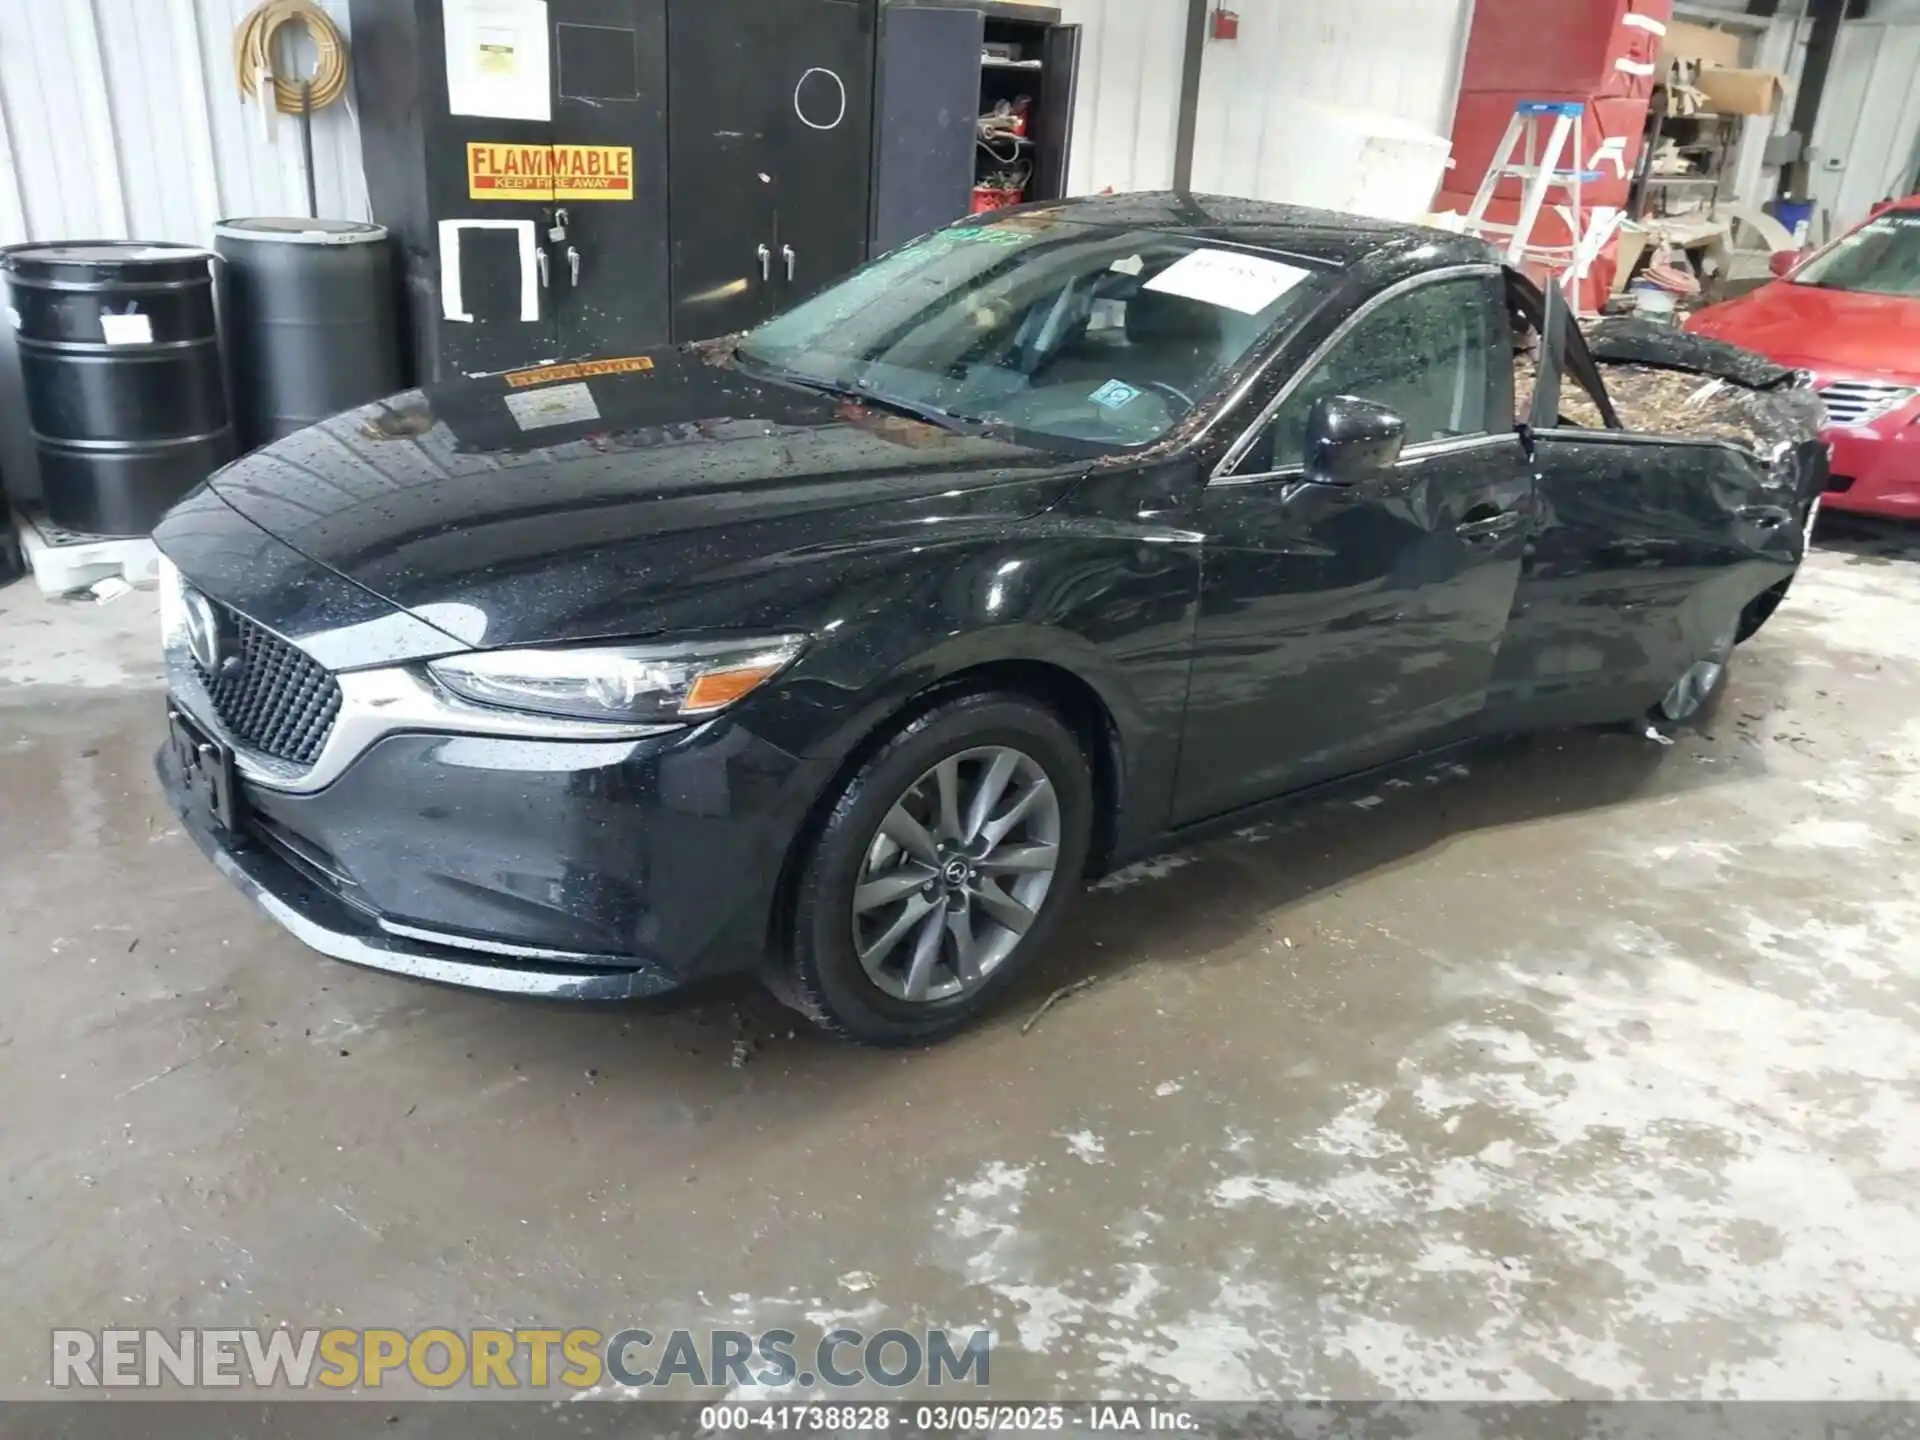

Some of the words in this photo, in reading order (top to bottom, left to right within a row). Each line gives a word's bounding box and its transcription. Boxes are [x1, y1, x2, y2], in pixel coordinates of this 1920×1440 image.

[472, 147, 629, 176] FLAMMABLE
[494, 178, 533, 188] KEEP
[536, 178, 569, 189] FIRE
[572, 178, 612, 189] AWAY
